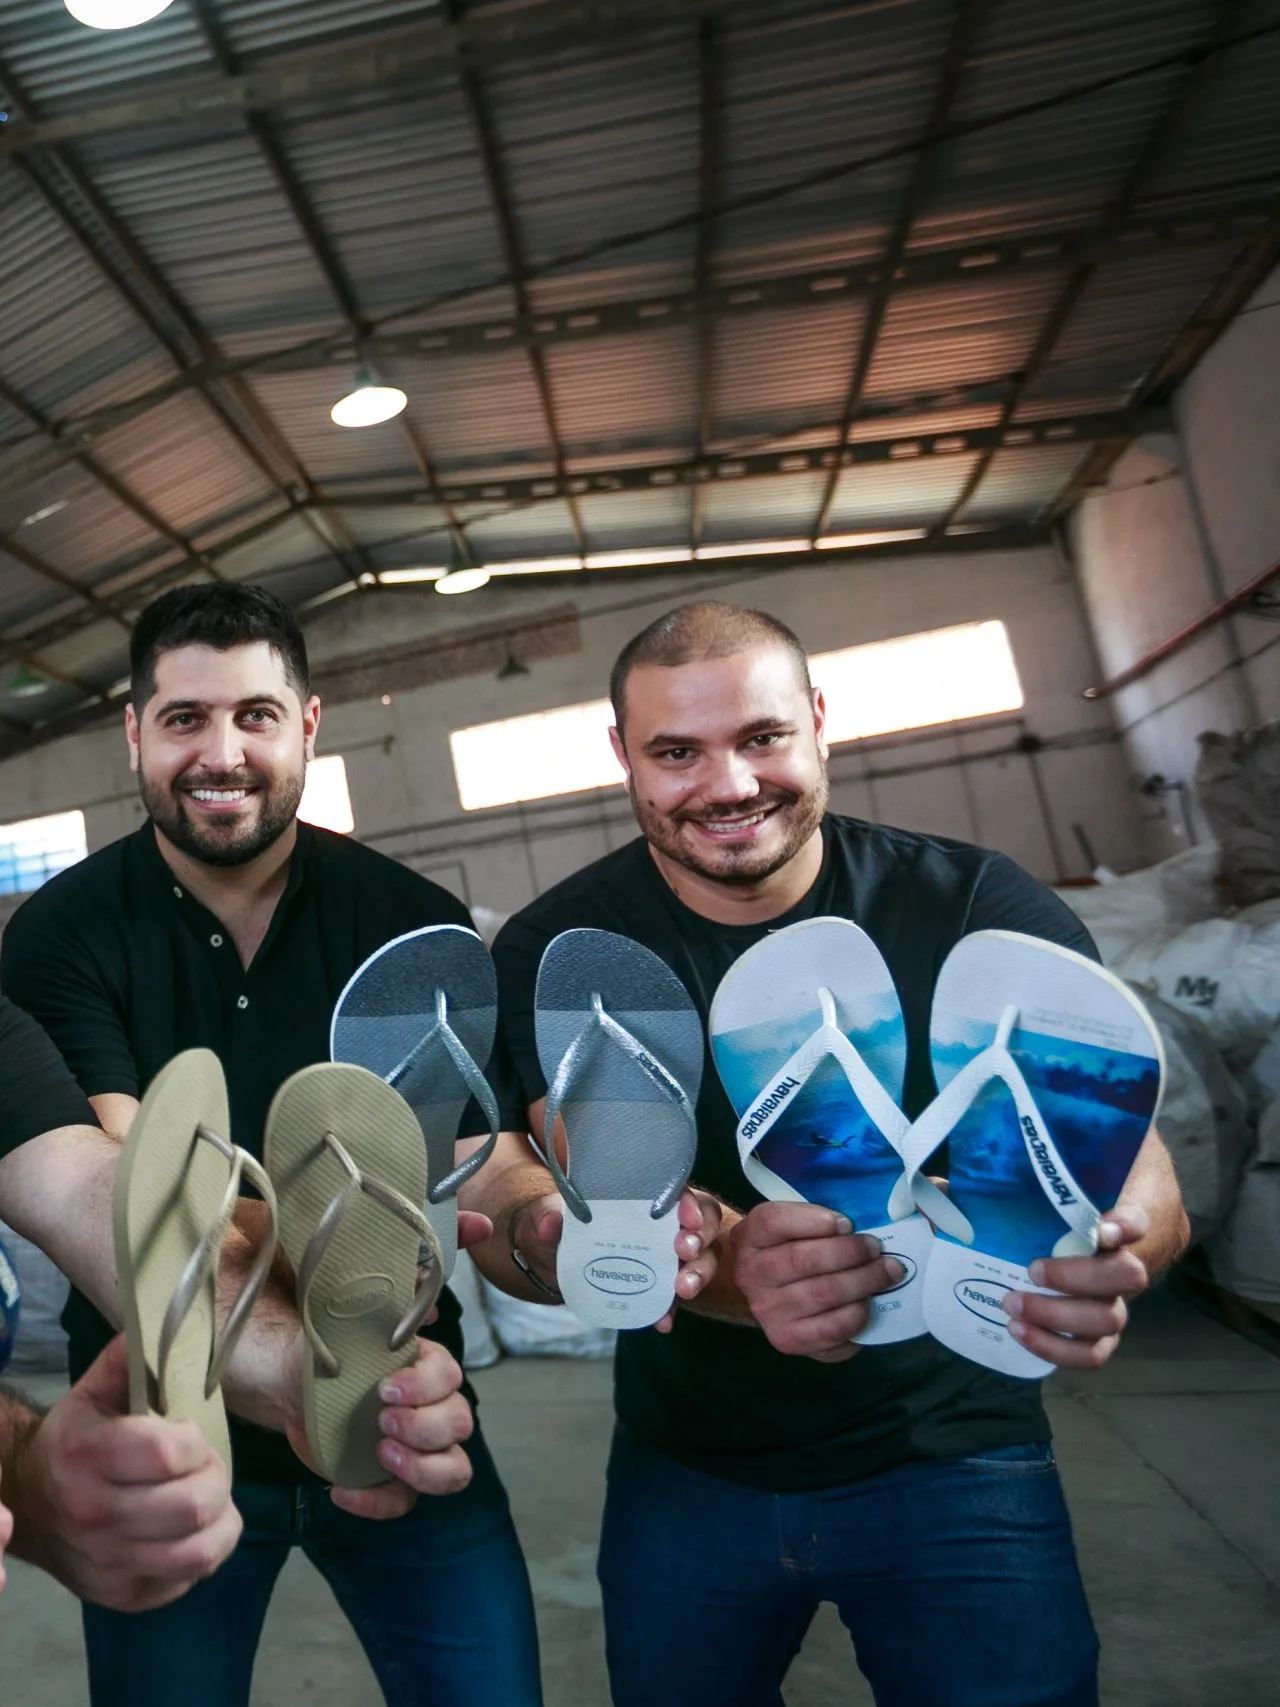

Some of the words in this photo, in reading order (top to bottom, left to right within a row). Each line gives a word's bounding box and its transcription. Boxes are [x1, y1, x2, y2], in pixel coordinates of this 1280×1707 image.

[741, 1076, 801, 1139] havaianas
[1020, 1115, 1078, 1206] havaianas
[591, 1267, 649, 1283] havaianas
[963, 1286, 1004, 1311] havai
